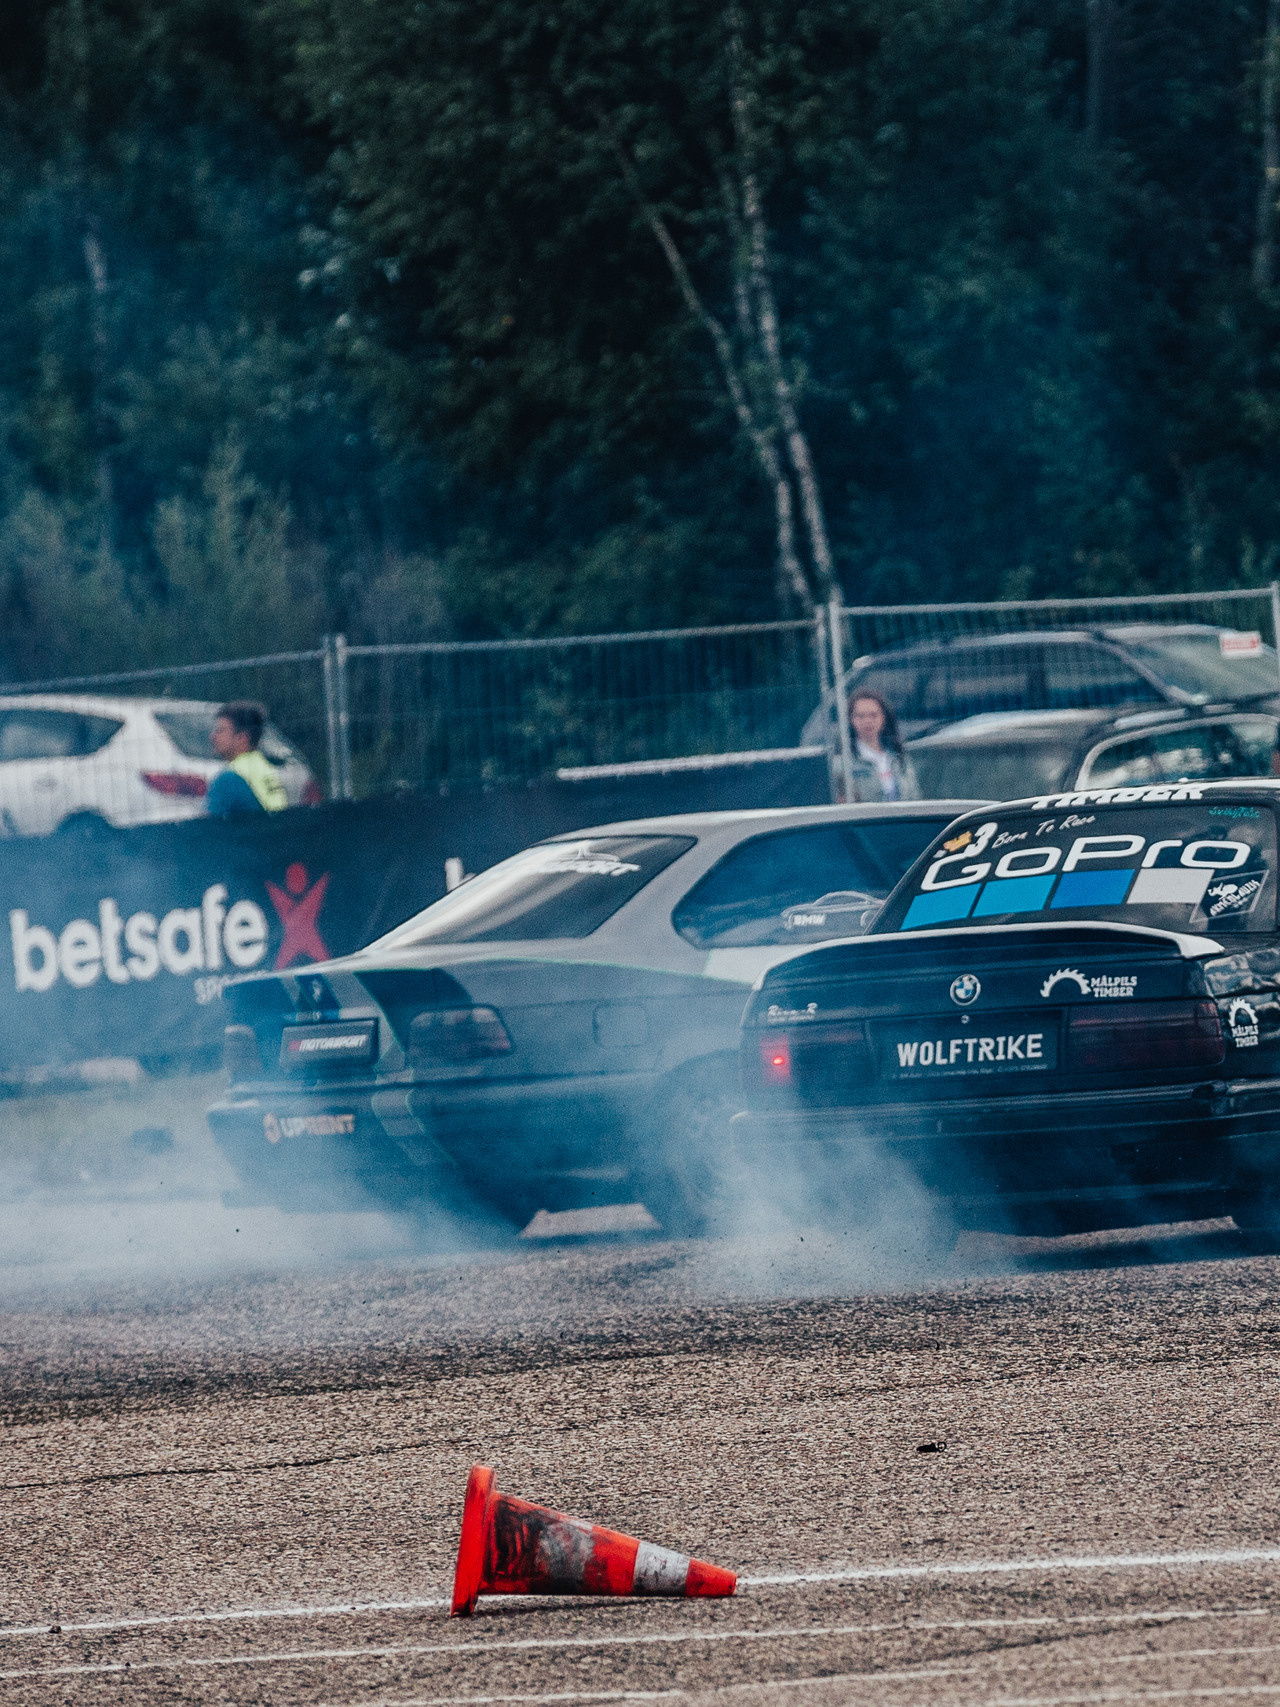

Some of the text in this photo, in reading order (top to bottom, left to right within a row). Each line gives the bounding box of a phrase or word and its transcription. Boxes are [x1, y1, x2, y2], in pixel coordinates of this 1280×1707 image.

[1035, 818, 1056, 836] To
[1059, 814, 1096, 831] Race
[920, 834, 1251, 891] GoPro
[9, 883, 269, 992] betsafe
[1093, 986, 1134, 997] TIMBER
[897, 1033, 1044, 1067] WOLFTRIKE
